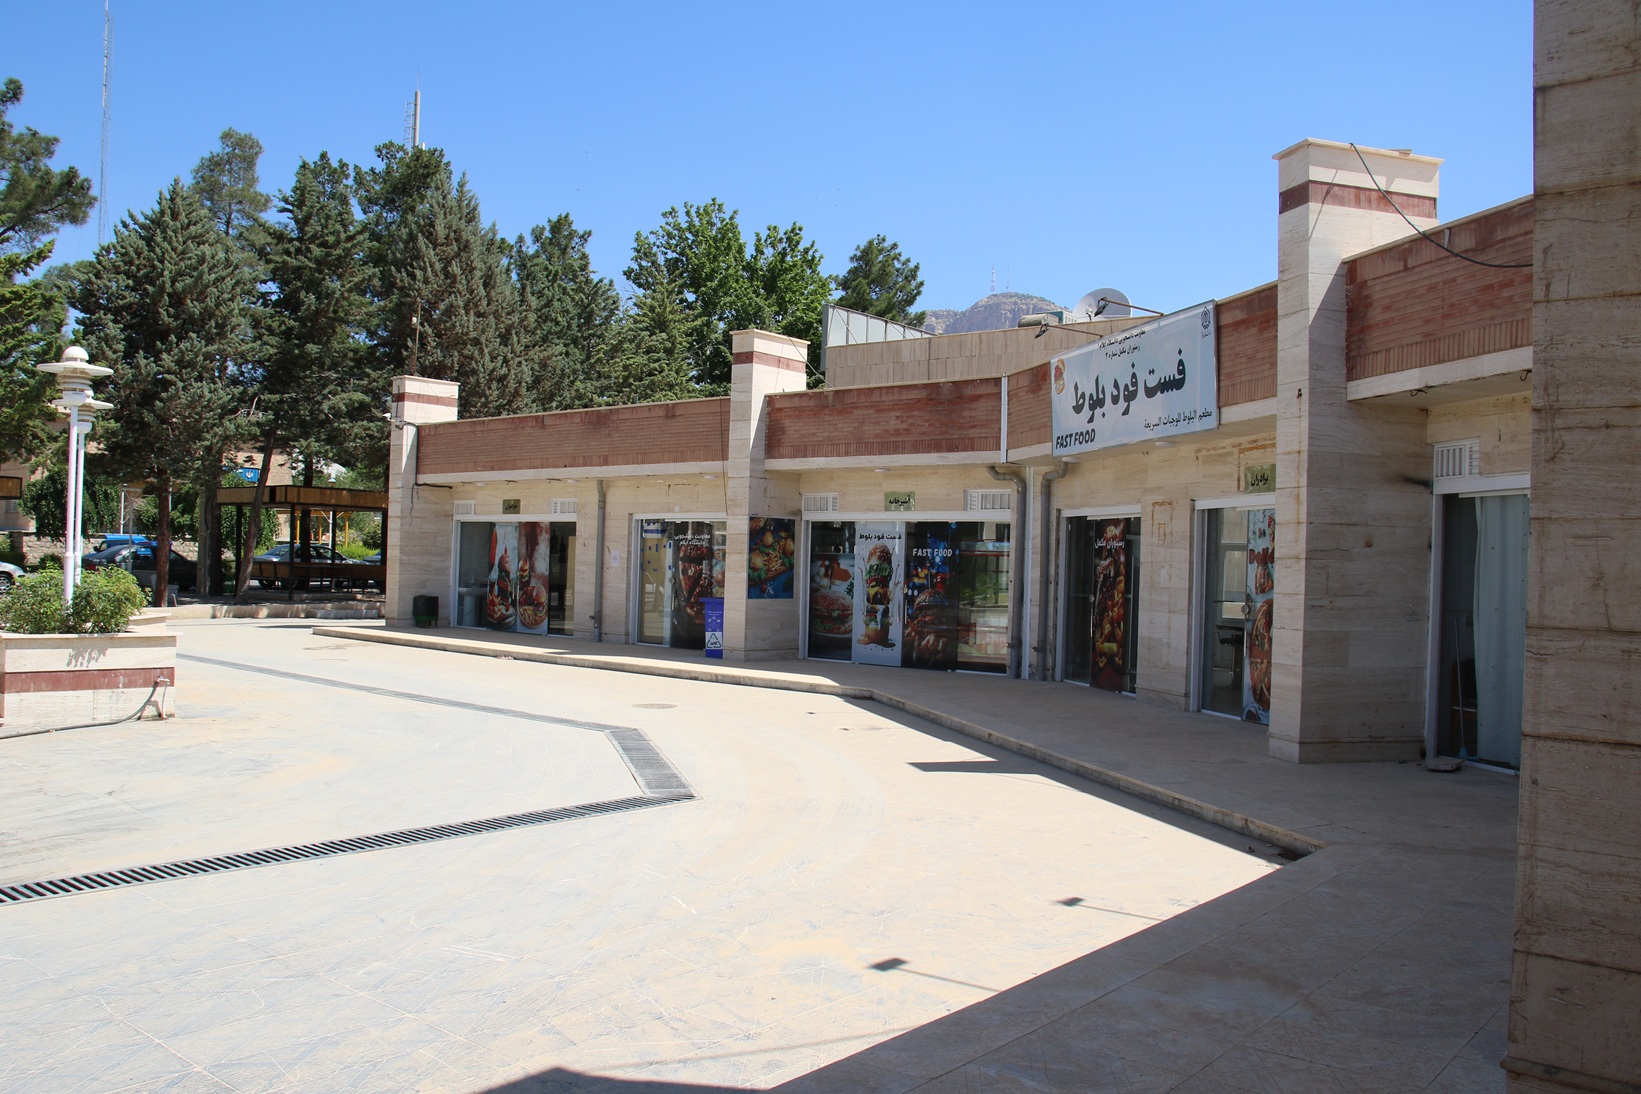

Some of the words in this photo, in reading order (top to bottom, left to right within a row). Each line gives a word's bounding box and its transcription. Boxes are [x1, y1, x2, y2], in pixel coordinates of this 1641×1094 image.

[1143, 348, 1187, 399] فست
[1110, 362, 1139, 416] فود
[1071, 375, 1106, 424] بلوط
[1162, 412, 1182, 427] للوجبات
[1182, 410, 1197, 424] البلوط
[1197, 407, 1213, 422] مطعم
[1055, 433, 1073, 450] FAST
[1073, 428, 1096, 446] FOOD
[1250, 472, 1269, 486] برادران
[888, 494, 911, 507] آشپزخانه
[859, 533, 873, 541] بلوط
[873, 533, 884, 541] فود
[1094, 537, 1107, 549] مکمل
[1106, 538, 1125, 549] رستوران
[912, 548, 931, 557] FAST
[933, 548, 953, 557] FOOD
